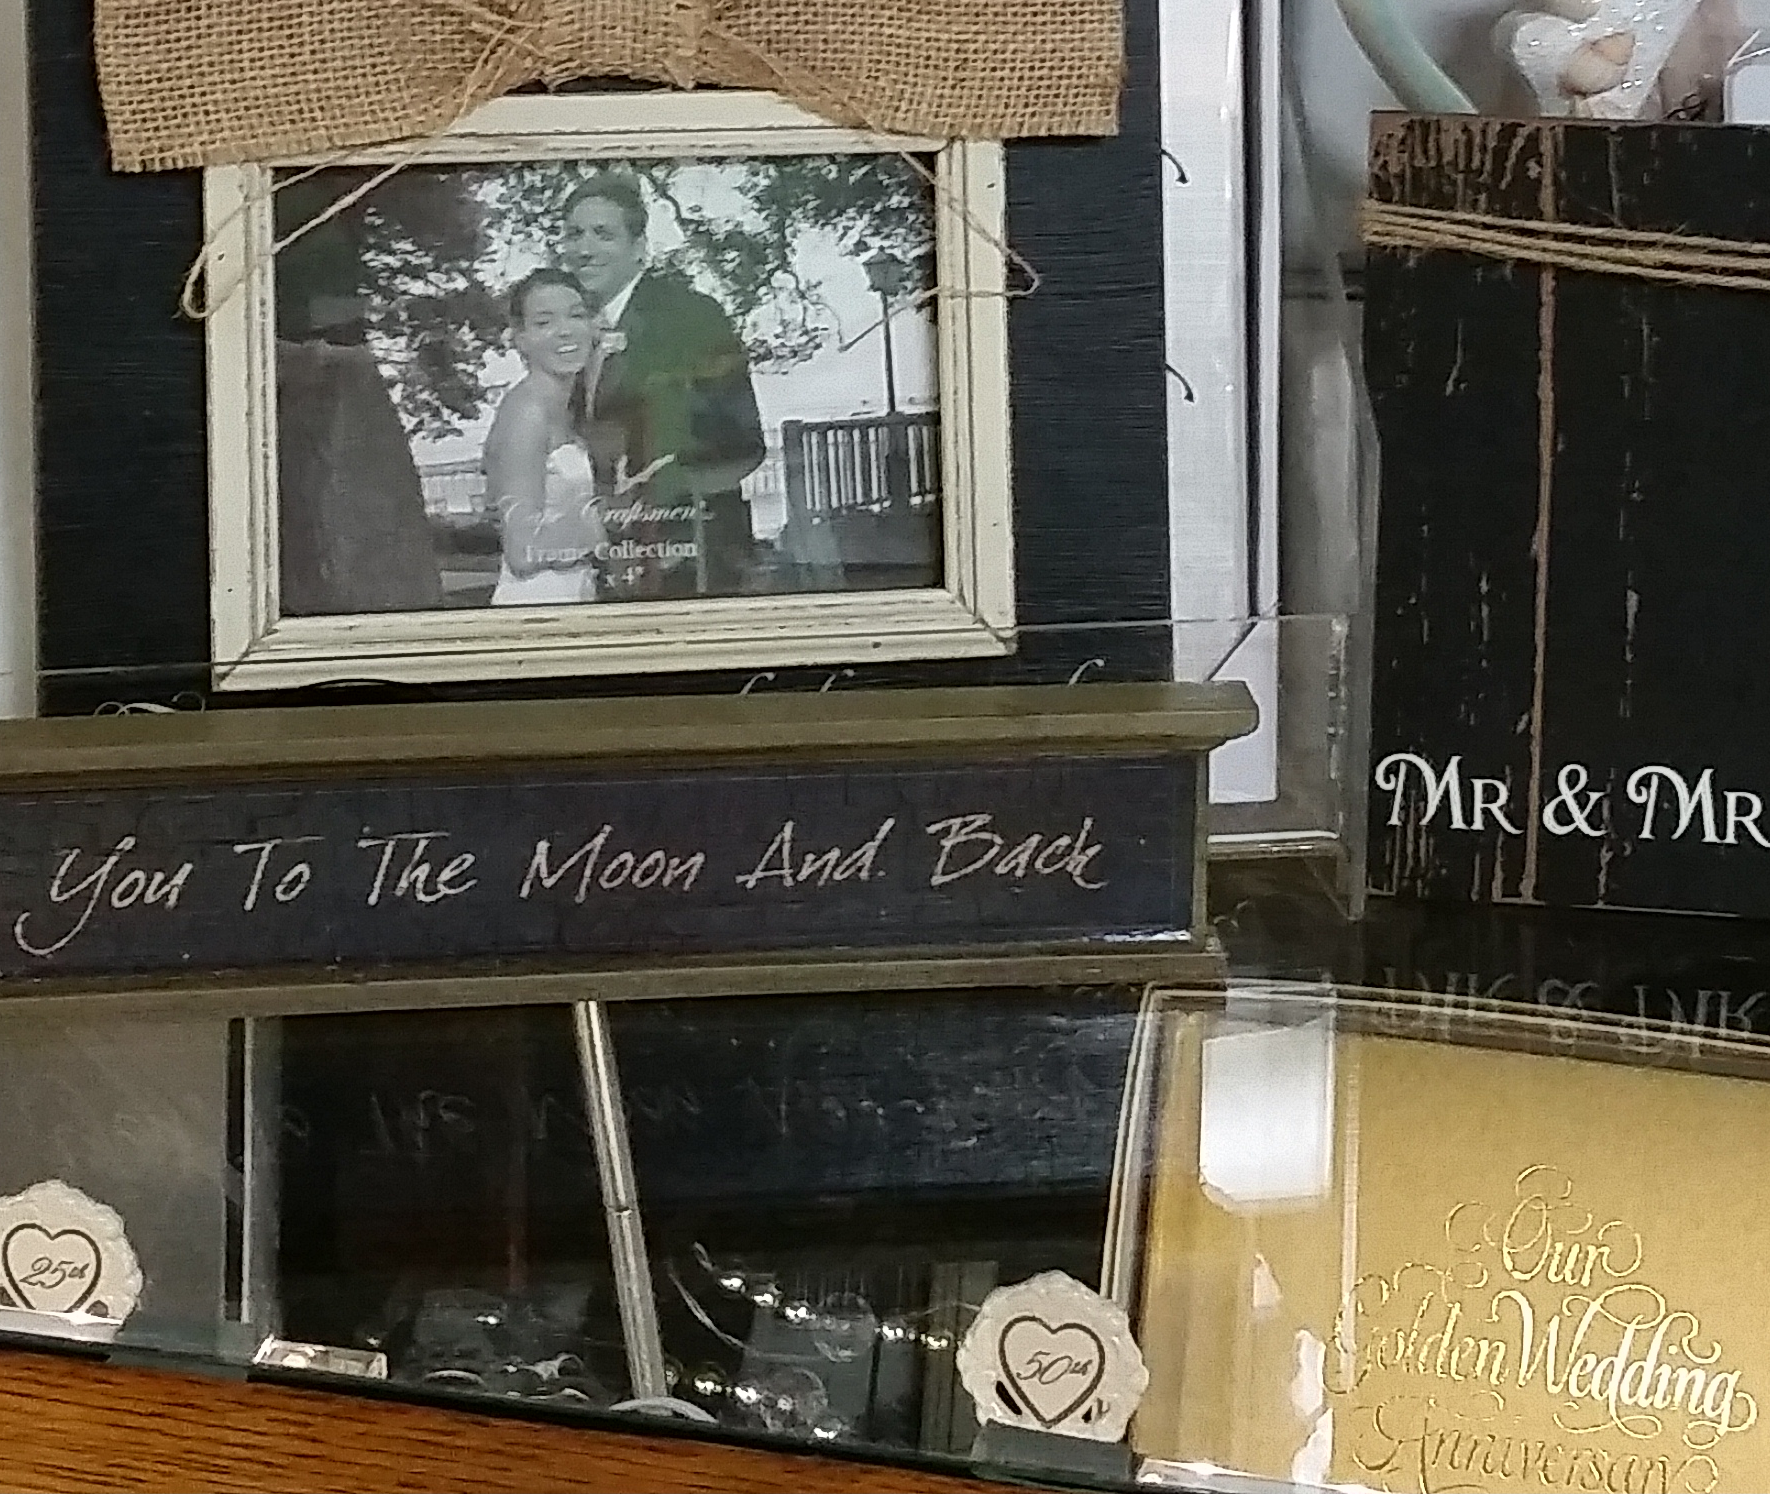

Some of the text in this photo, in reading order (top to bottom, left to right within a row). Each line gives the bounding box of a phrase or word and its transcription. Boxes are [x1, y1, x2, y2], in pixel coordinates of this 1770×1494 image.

[594, 539, 699, 561] Collection
[1541, 763, 1611, 839] &
[14, 835, 194, 958] You
[232, 834, 322, 910] To
[358, 826, 478, 906] The
[522, 824, 706, 903] Moon
[926, 812, 1110, 891] Back
[1469, 1168, 1642, 1287] Our
[1491, 1285, 1758, 1437] Wedding
